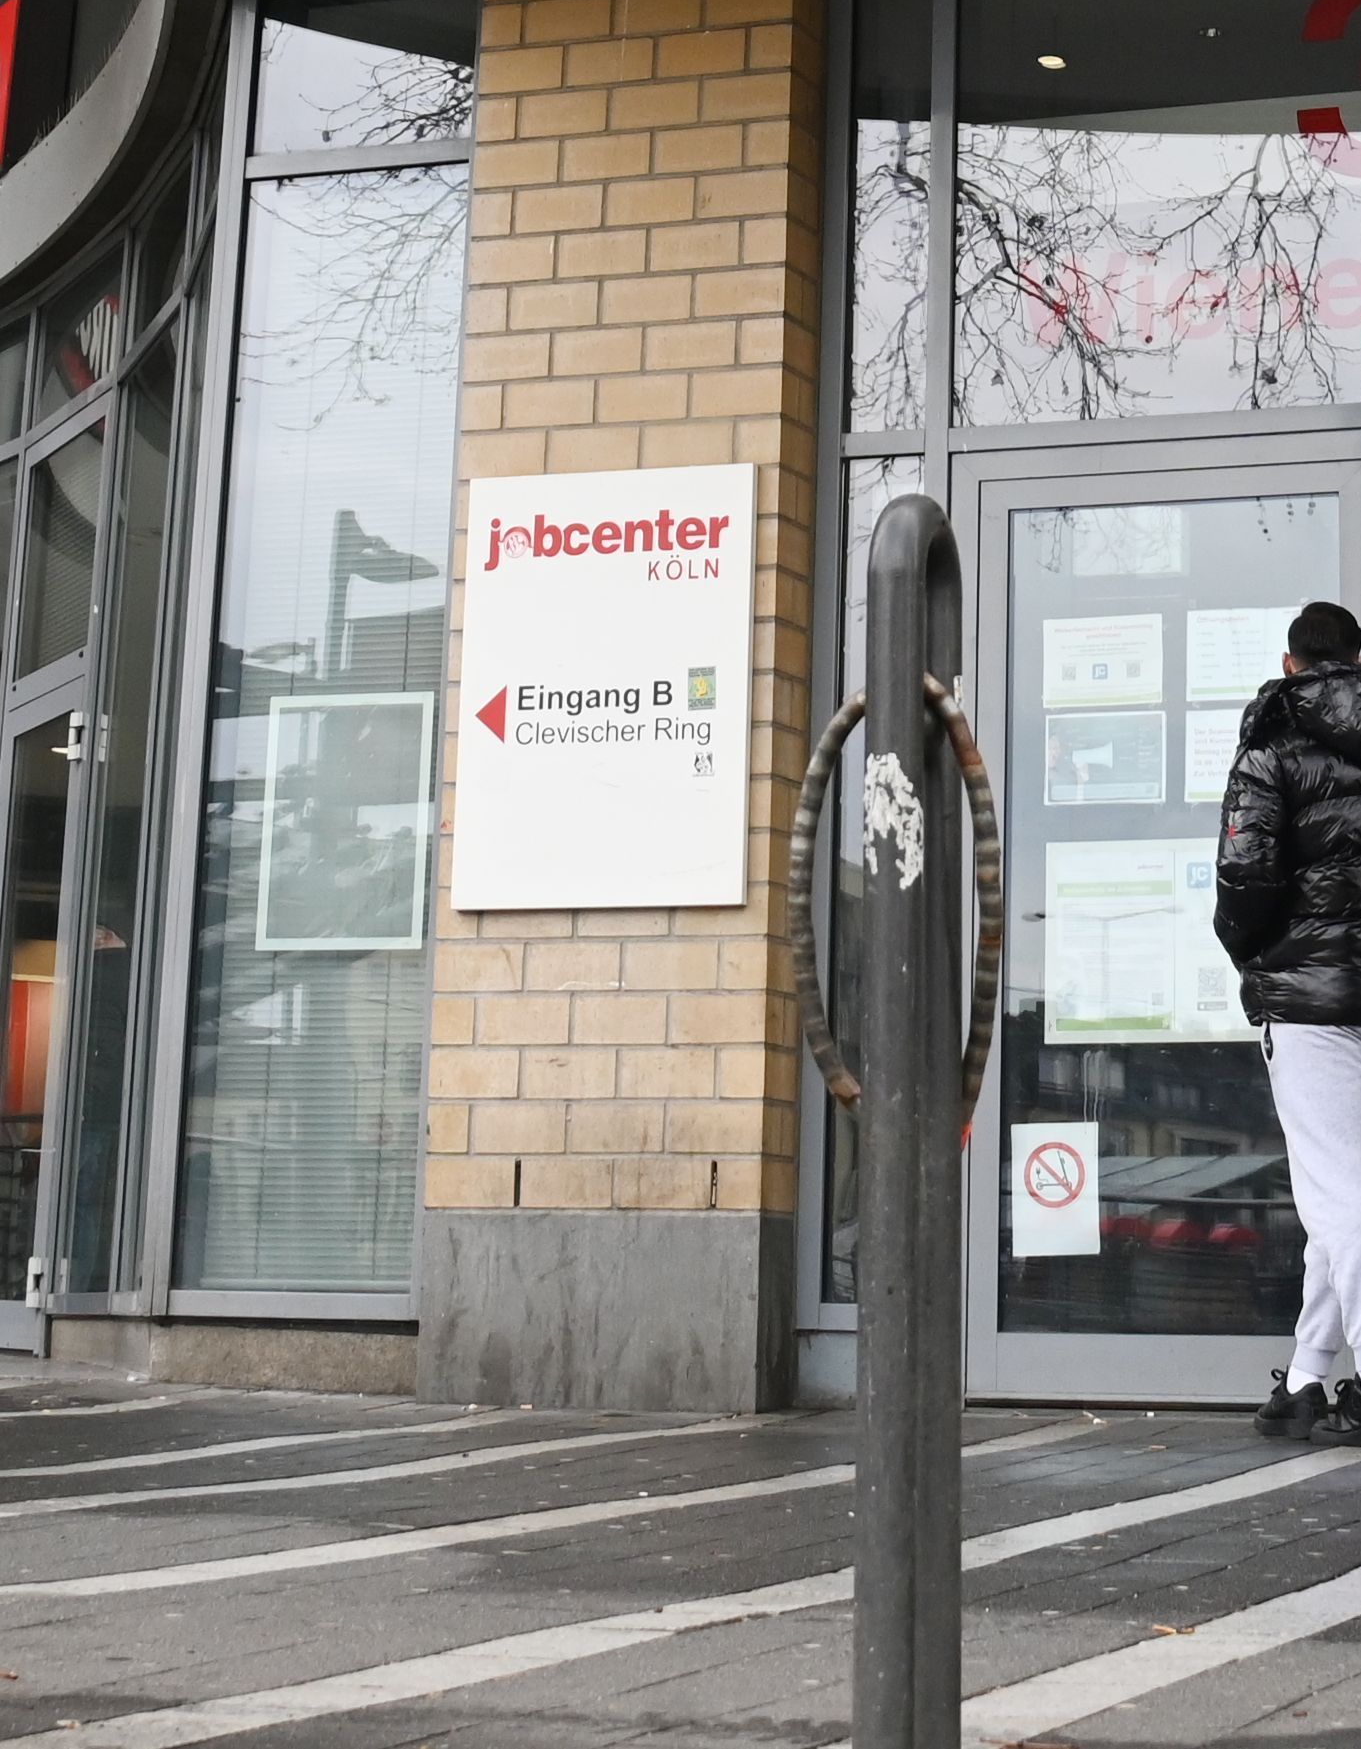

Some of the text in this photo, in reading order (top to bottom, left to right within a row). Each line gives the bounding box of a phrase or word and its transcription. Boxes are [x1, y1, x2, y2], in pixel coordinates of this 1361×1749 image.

[483, 508, 730, 572] jobcenter
[647, 555, 720, 582] KÖLN
[516, 684, 641, 716] Eingang
[652, 680, 674, 707] B
[515, 716, 712, 746] Clevischer Ring
